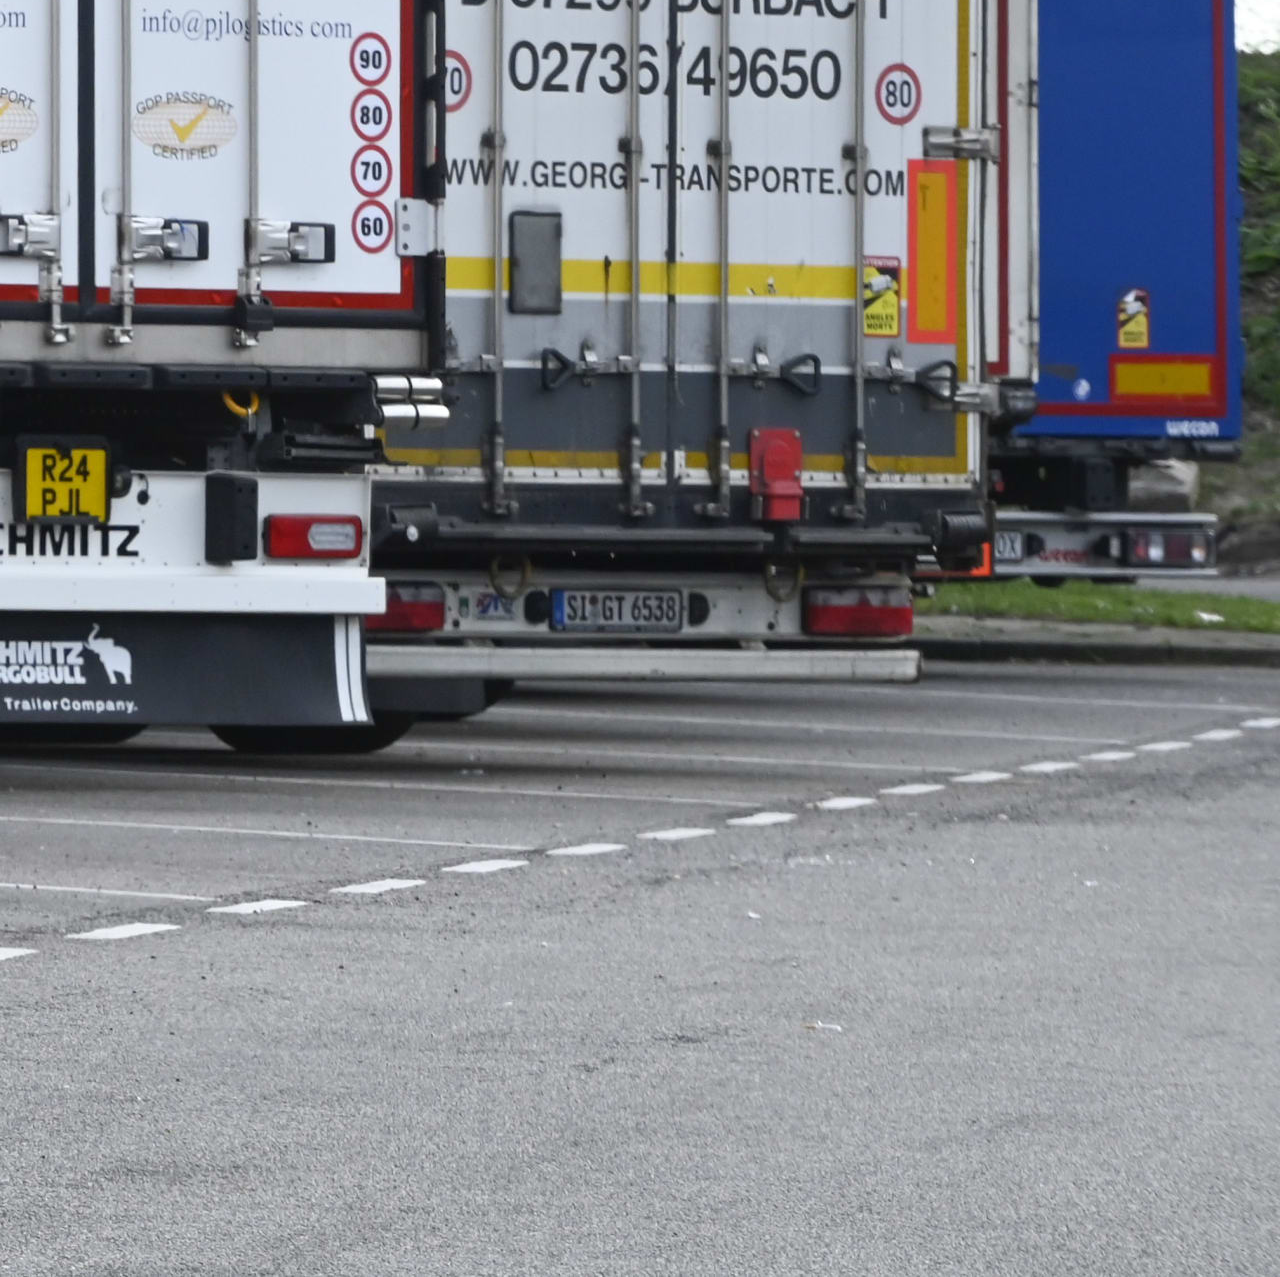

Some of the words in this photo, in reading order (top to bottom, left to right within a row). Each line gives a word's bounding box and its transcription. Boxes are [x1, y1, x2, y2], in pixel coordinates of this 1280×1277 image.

[359, 50, 382, 69] 90
[443, 67, 463, 95] 0
[886, 80, 912, 108] 80
[136, 95, 163, 115] GDP
[166, 91, 234, 116] PASSPORT
[360, 106, 383, 125] 80
[152, 143, 218, 161] CERTIFIED
[360, 161, 382, 181] 70
[444, 158, 905, 197] WWW.GEORG-TRANSPORTE.COM
[360, 217, 383, 236] 60
[42, 453, 90, 482] R24
[42, 488, 90, 516] PJL
[567, 594, 589, 622] SI
[602, 594, 624, 622] GT
[631, 595, 677, 622] 6538
